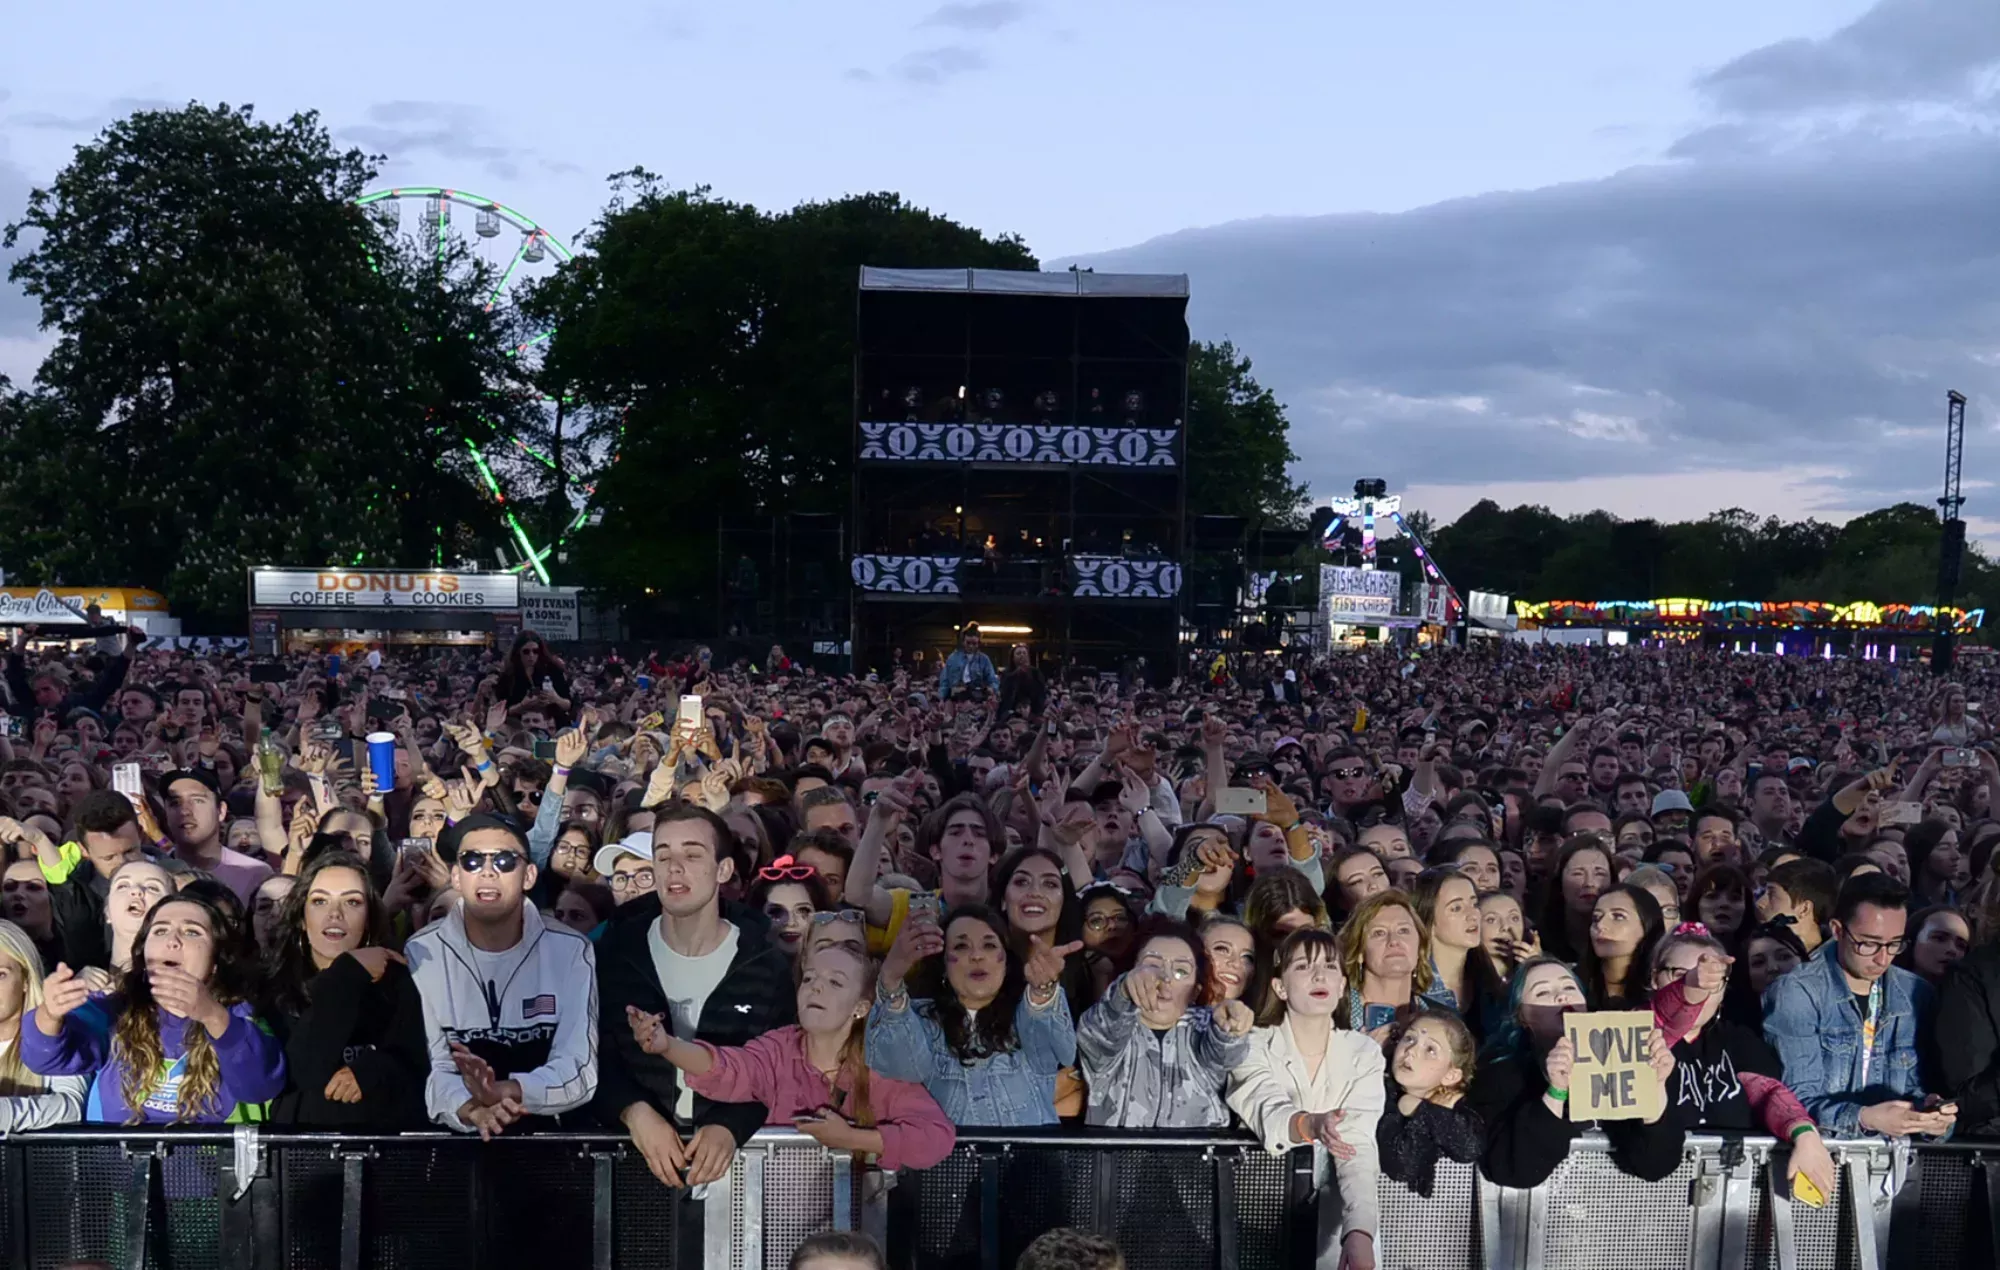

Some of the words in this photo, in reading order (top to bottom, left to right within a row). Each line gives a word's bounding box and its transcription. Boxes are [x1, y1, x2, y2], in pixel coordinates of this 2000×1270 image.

[317, 573, 459, 592] DONUTS
[1364, 572, 1389, 594] CHIPS
[290, 591, 355, 605] COFFEE
[382, 592, 393, 605] &
[412, 592, 484, 605] COOKIES
[543, 598, 575, 609] EVANS
[526, 610, 533, 619] &
[535, 610, 561, 620] SONS
[1590, 1070, 1636, 1108] ME
